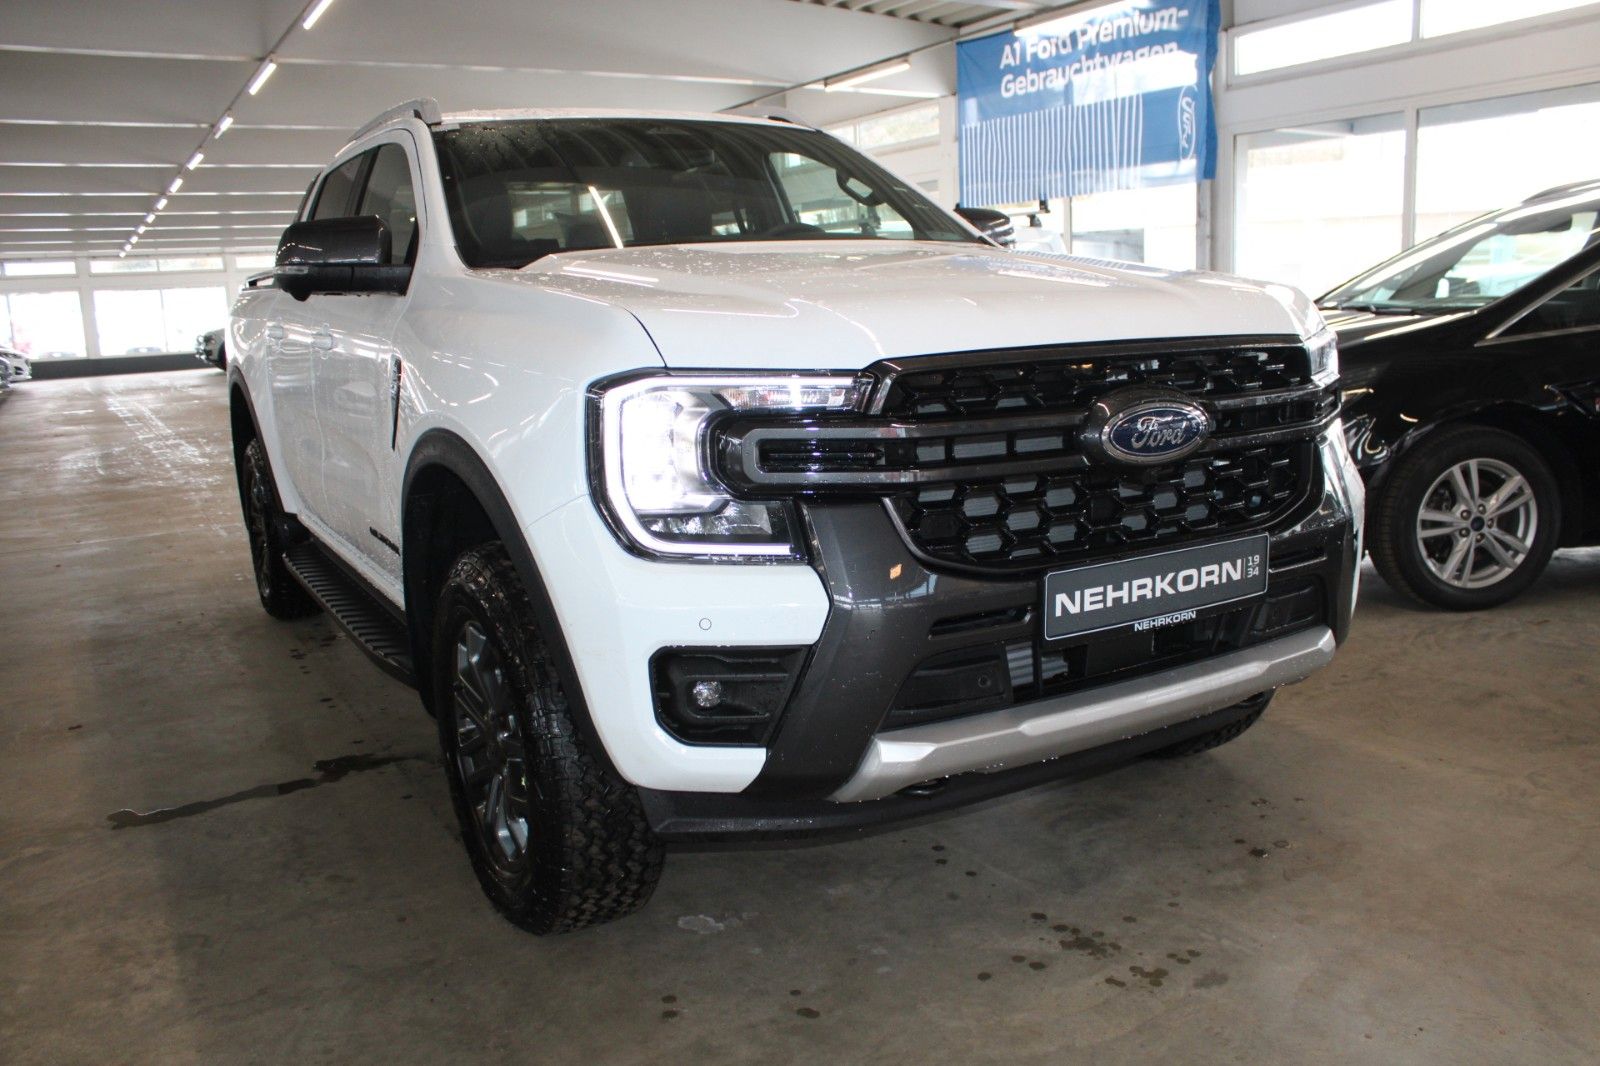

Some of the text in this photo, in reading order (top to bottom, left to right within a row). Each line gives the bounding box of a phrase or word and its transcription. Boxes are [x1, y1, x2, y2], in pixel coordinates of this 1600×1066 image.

[1000, 8, 1189, 69] A1 Ford Premium-
[1131, 415, 1188, 449] Ford
[1247, 554, 1260, 566] 19
[1247, 566, 1259, 578] 34
[1055, 559, 1242, 617] NEHRKORN
[1134, 611, 1197, 632] NEHRKORN
